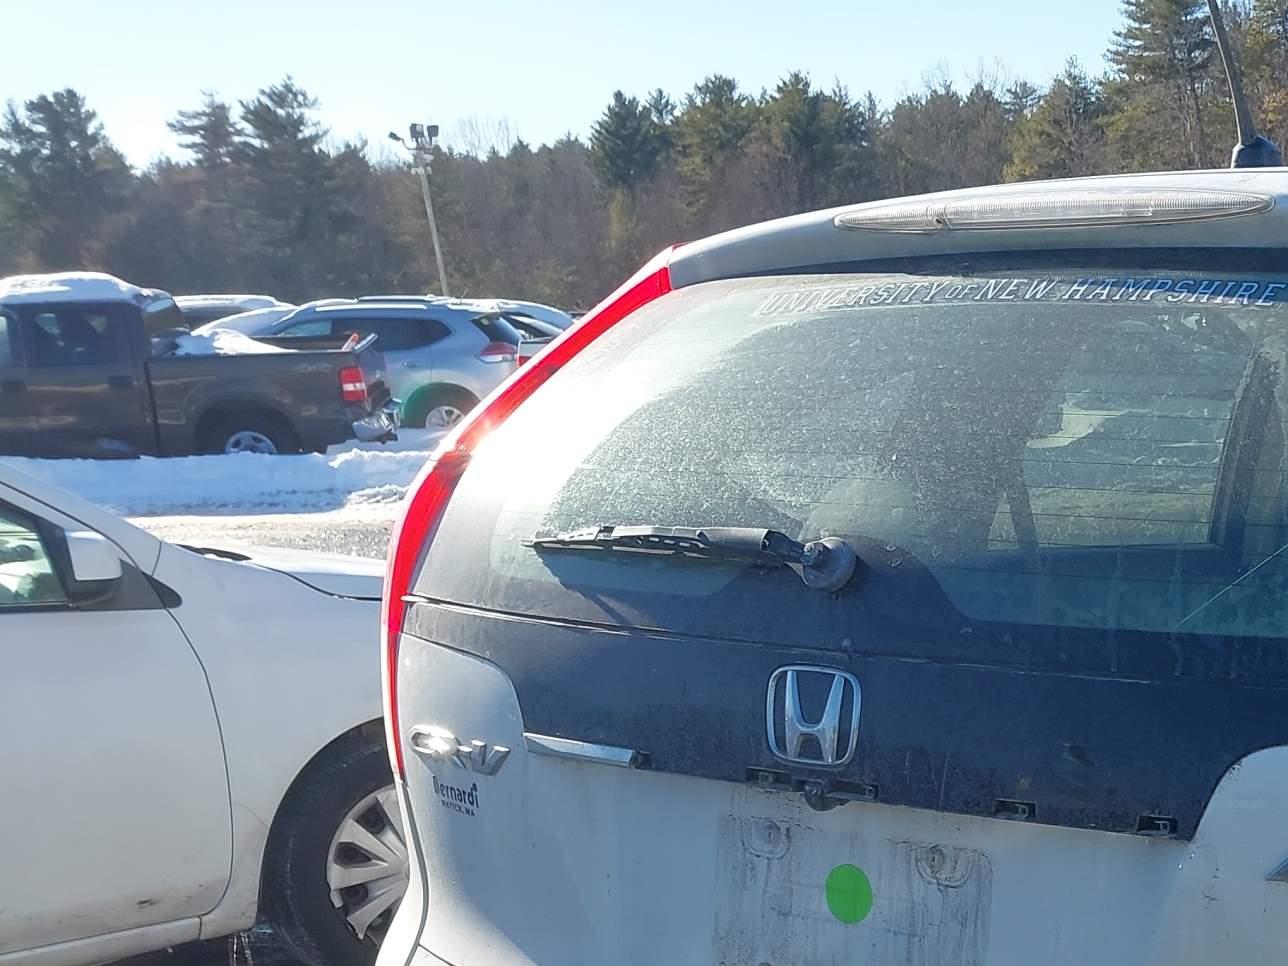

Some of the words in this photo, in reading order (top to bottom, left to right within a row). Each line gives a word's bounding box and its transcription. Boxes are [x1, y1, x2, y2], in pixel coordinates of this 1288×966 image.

[758, 281, 950, 315] UNIVERSITY
[944, 283, 978, 299] OF
[974, 279, 1057, 300] NEW
[1061, 278, 1287, 306] HAMPSHIRE
